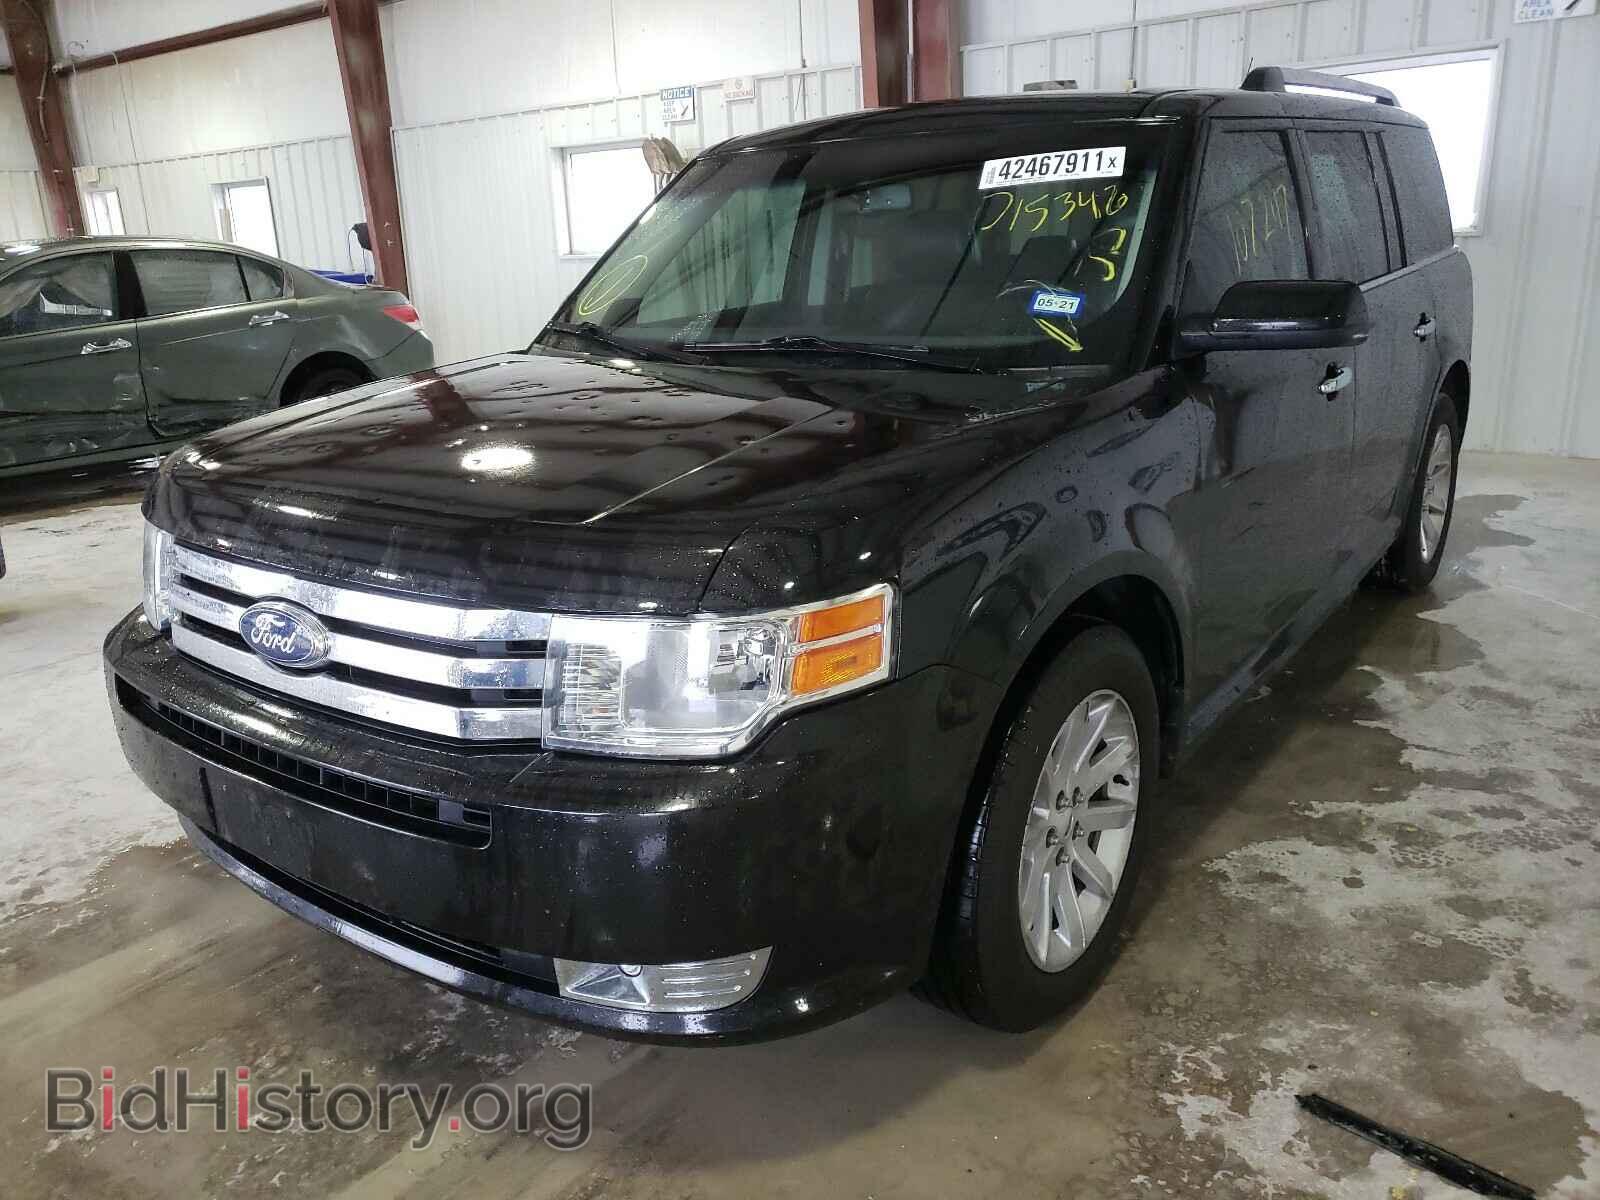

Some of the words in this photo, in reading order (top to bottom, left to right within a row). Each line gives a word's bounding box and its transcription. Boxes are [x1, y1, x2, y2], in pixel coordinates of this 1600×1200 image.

[662, 87, 691, 99] NOTICE
[999, 150, 1104, 180] 42467911
[250, 613, 297, 654] Ford
